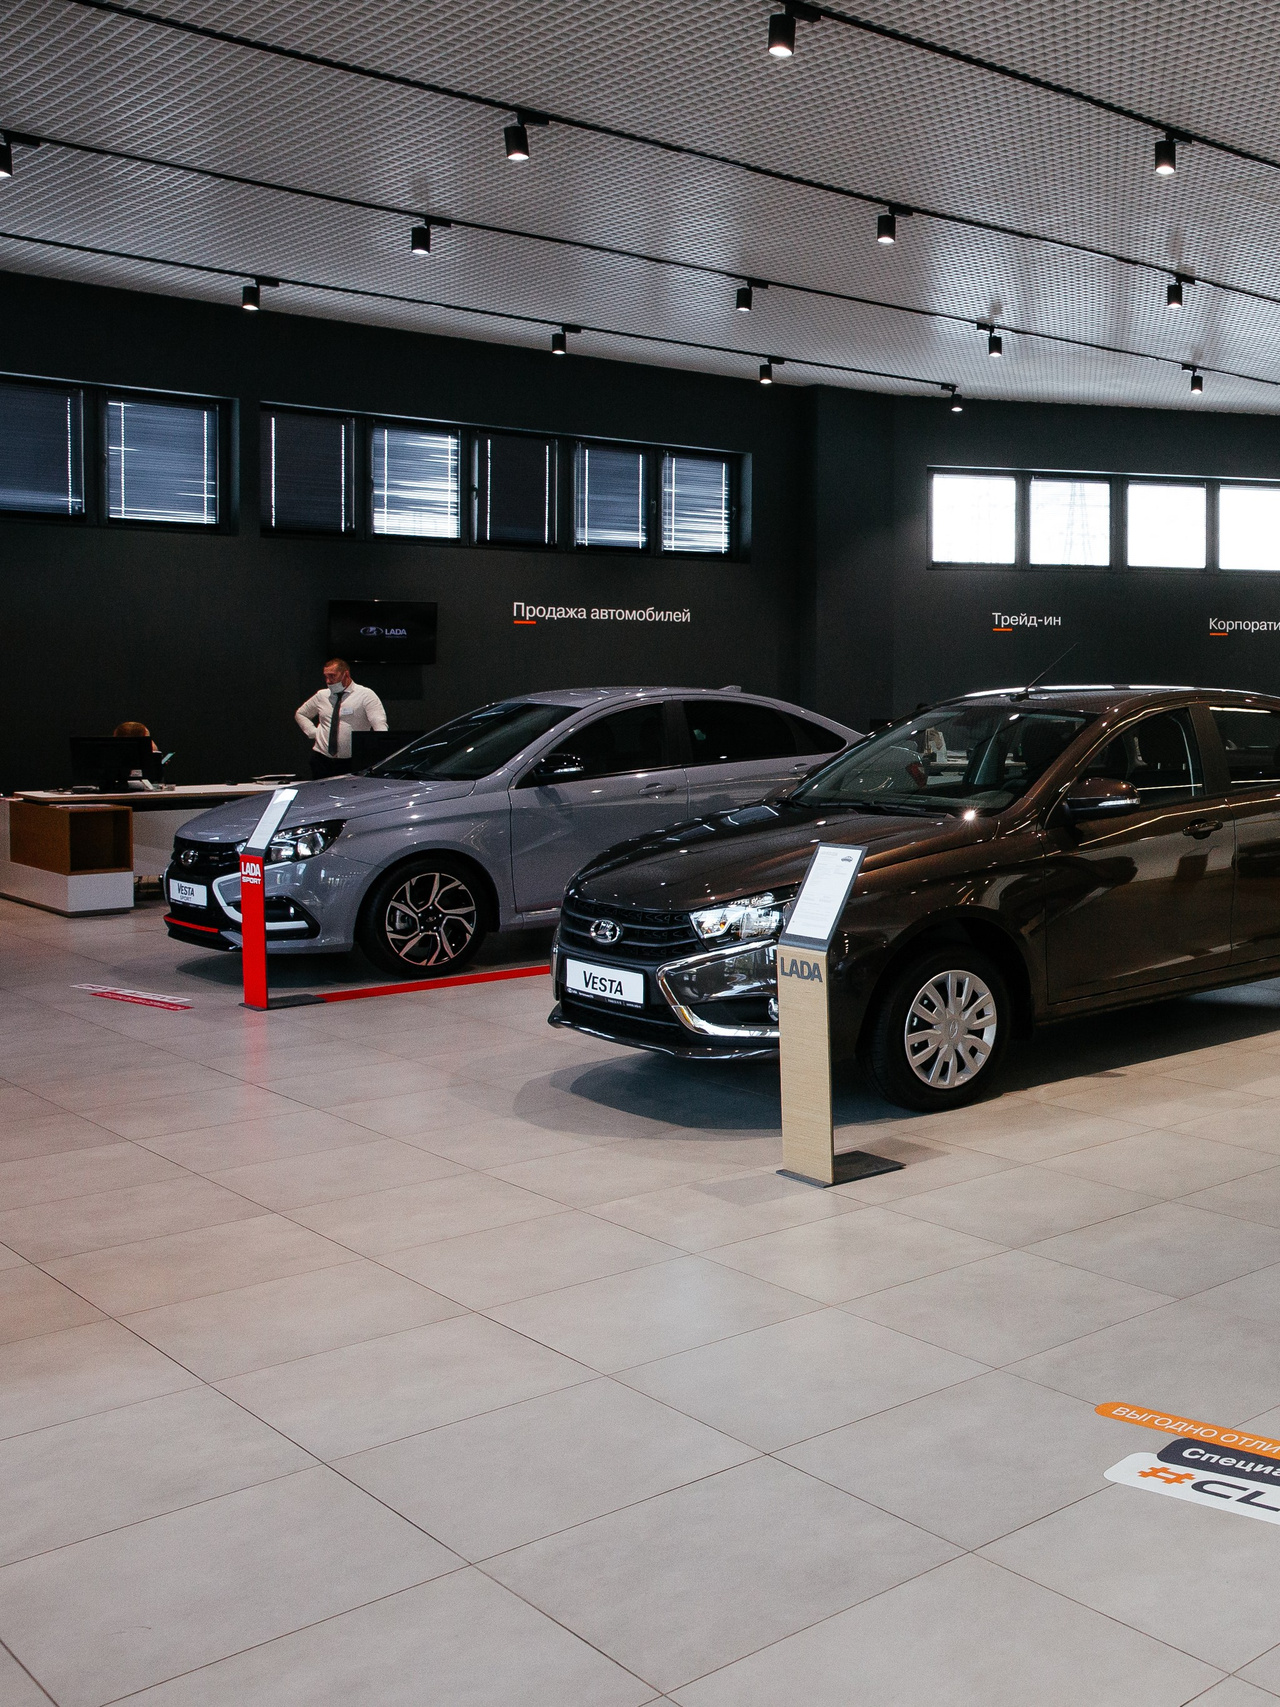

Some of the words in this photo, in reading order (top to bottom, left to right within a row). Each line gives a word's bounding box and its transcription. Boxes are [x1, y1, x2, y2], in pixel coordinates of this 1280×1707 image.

[513, 602, 587, 620] Продажа
[590, 607, 691, 623] автомобилей
[992, 612, 1061, 628] Трейд-ин
[241, 862, 262, 878] LADA
[241, 876, 262, 885] SPORT
[177, 883, 195, 897] VESTA
[780, 957, 823, 983] LADA
[583, 970, 624, 996] VESTA
[1111, 1406, 1218, 1439] ВЫГОДНО
